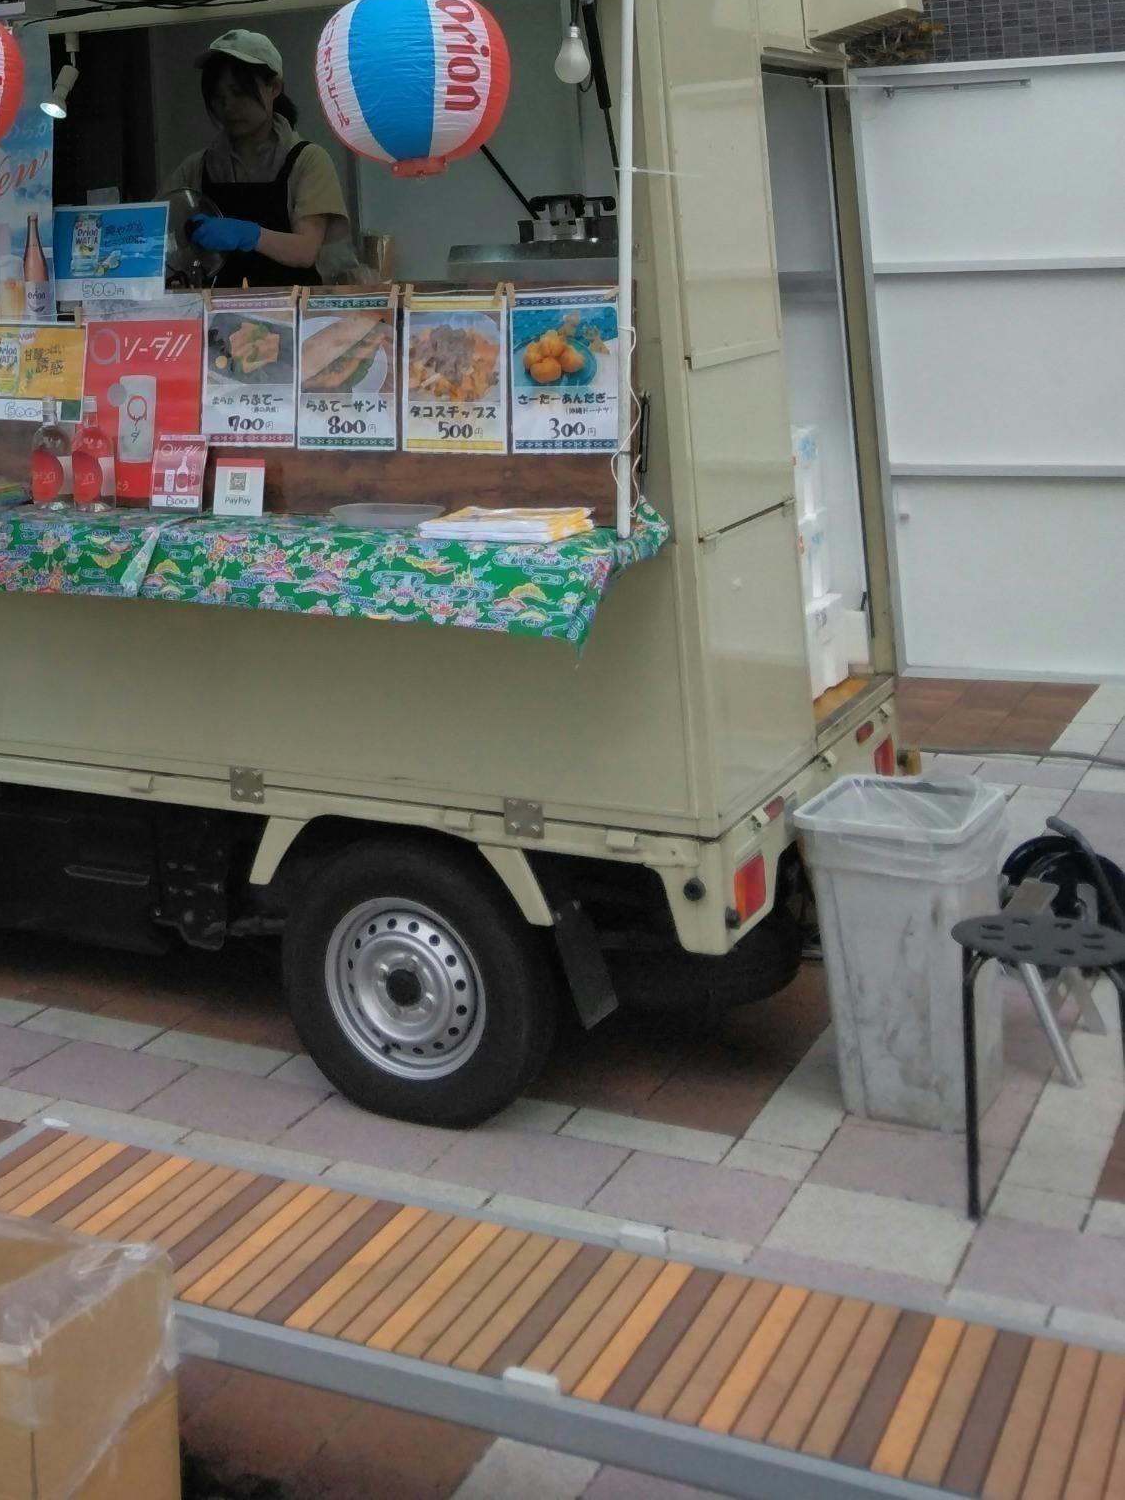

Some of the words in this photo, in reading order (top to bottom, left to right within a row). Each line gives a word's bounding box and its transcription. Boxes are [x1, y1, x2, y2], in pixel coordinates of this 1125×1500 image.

[239, 394, 284, 406] らふてー
[306, 400, 387, 413] らふてーサンド
[410, 405, 497, 419] タコスチップス
[224, 496, 252, 506] PayPay
